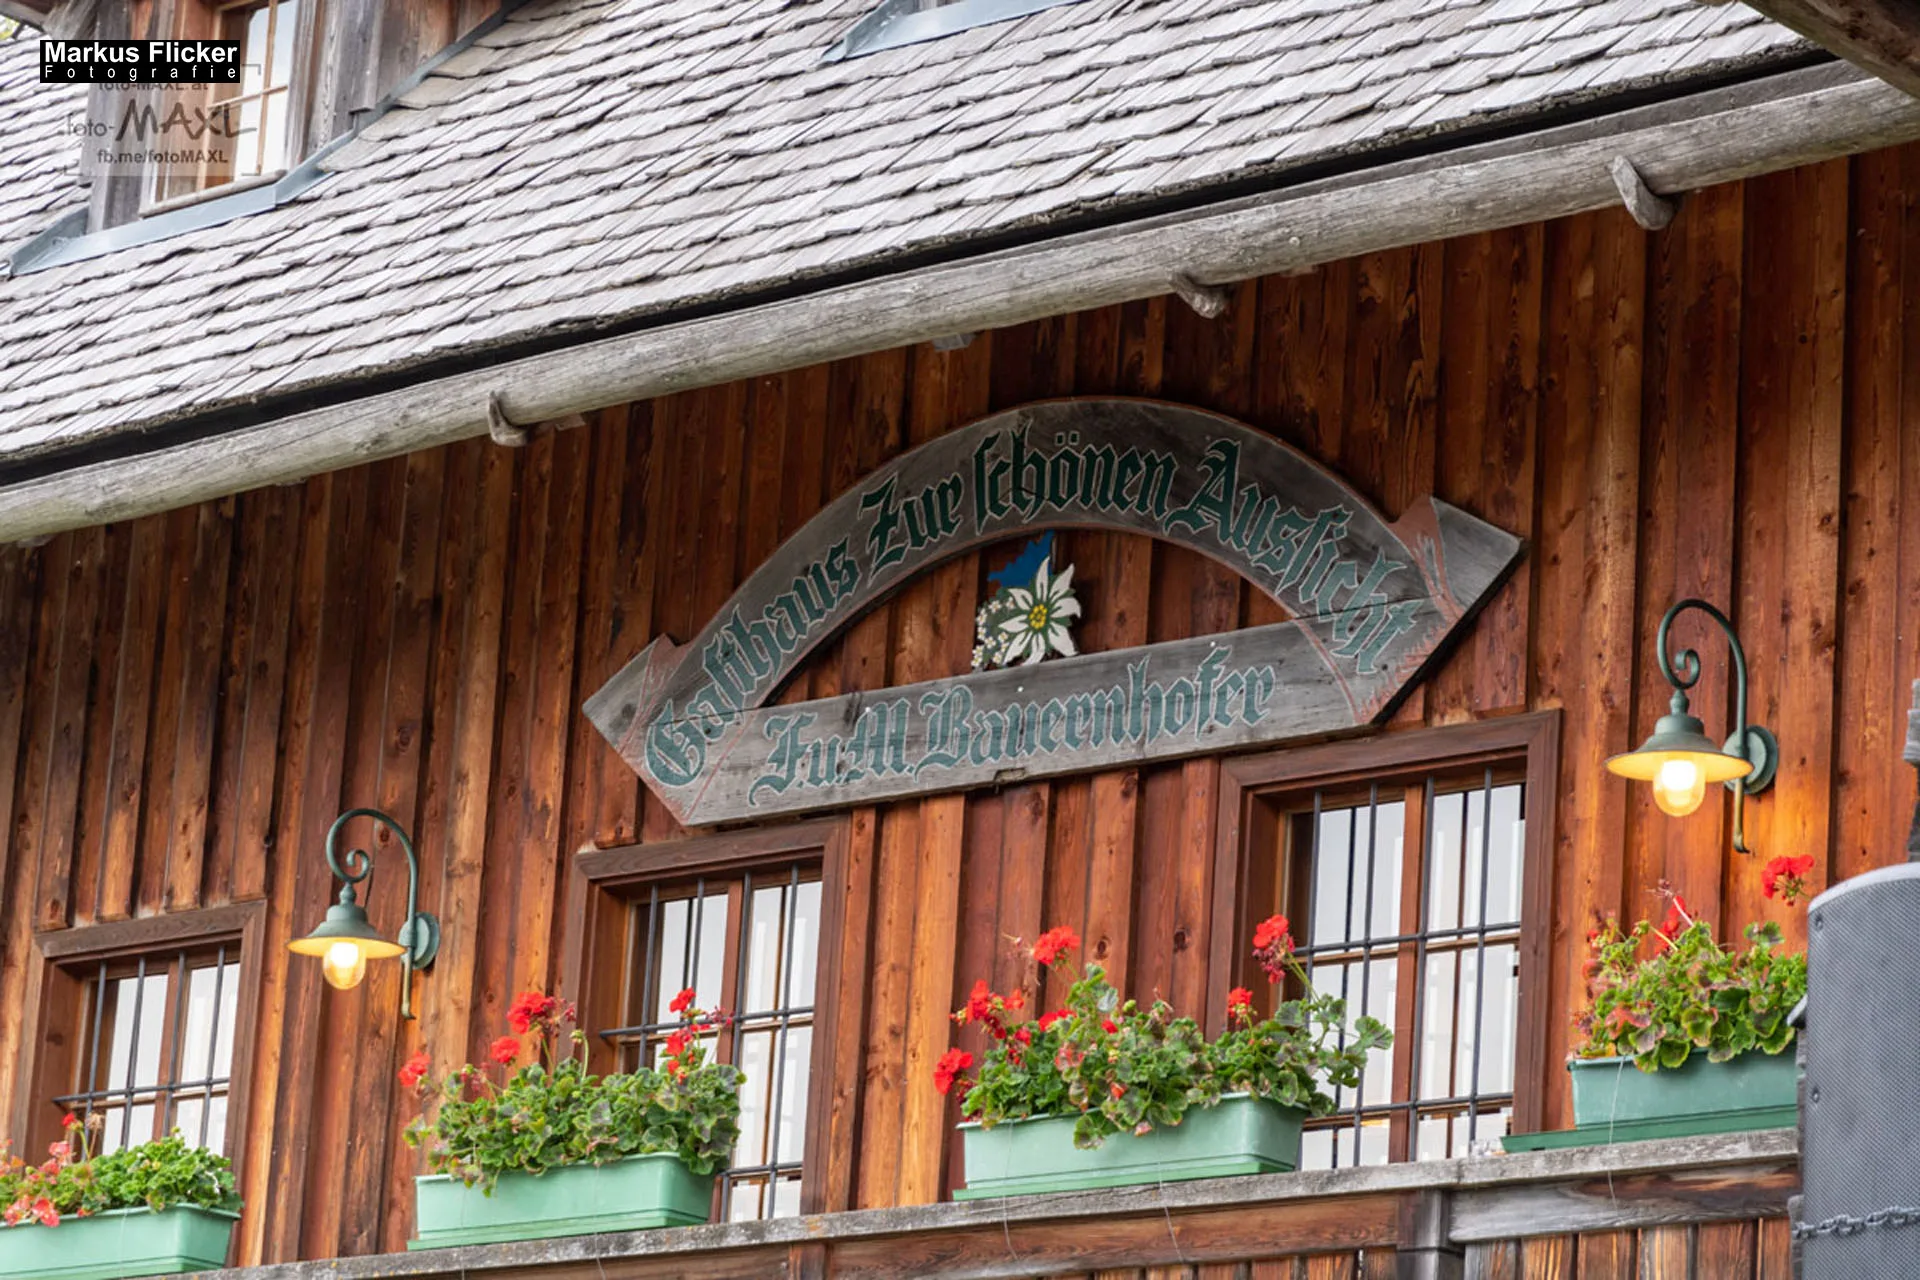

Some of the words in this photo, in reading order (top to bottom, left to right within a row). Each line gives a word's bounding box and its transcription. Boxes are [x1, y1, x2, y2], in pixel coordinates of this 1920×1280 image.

[644, 536, 862, 787] Gasthaus
[858, 472, 963, 588] Zur
[914, 645, 1276, 783] Bauernhofer
